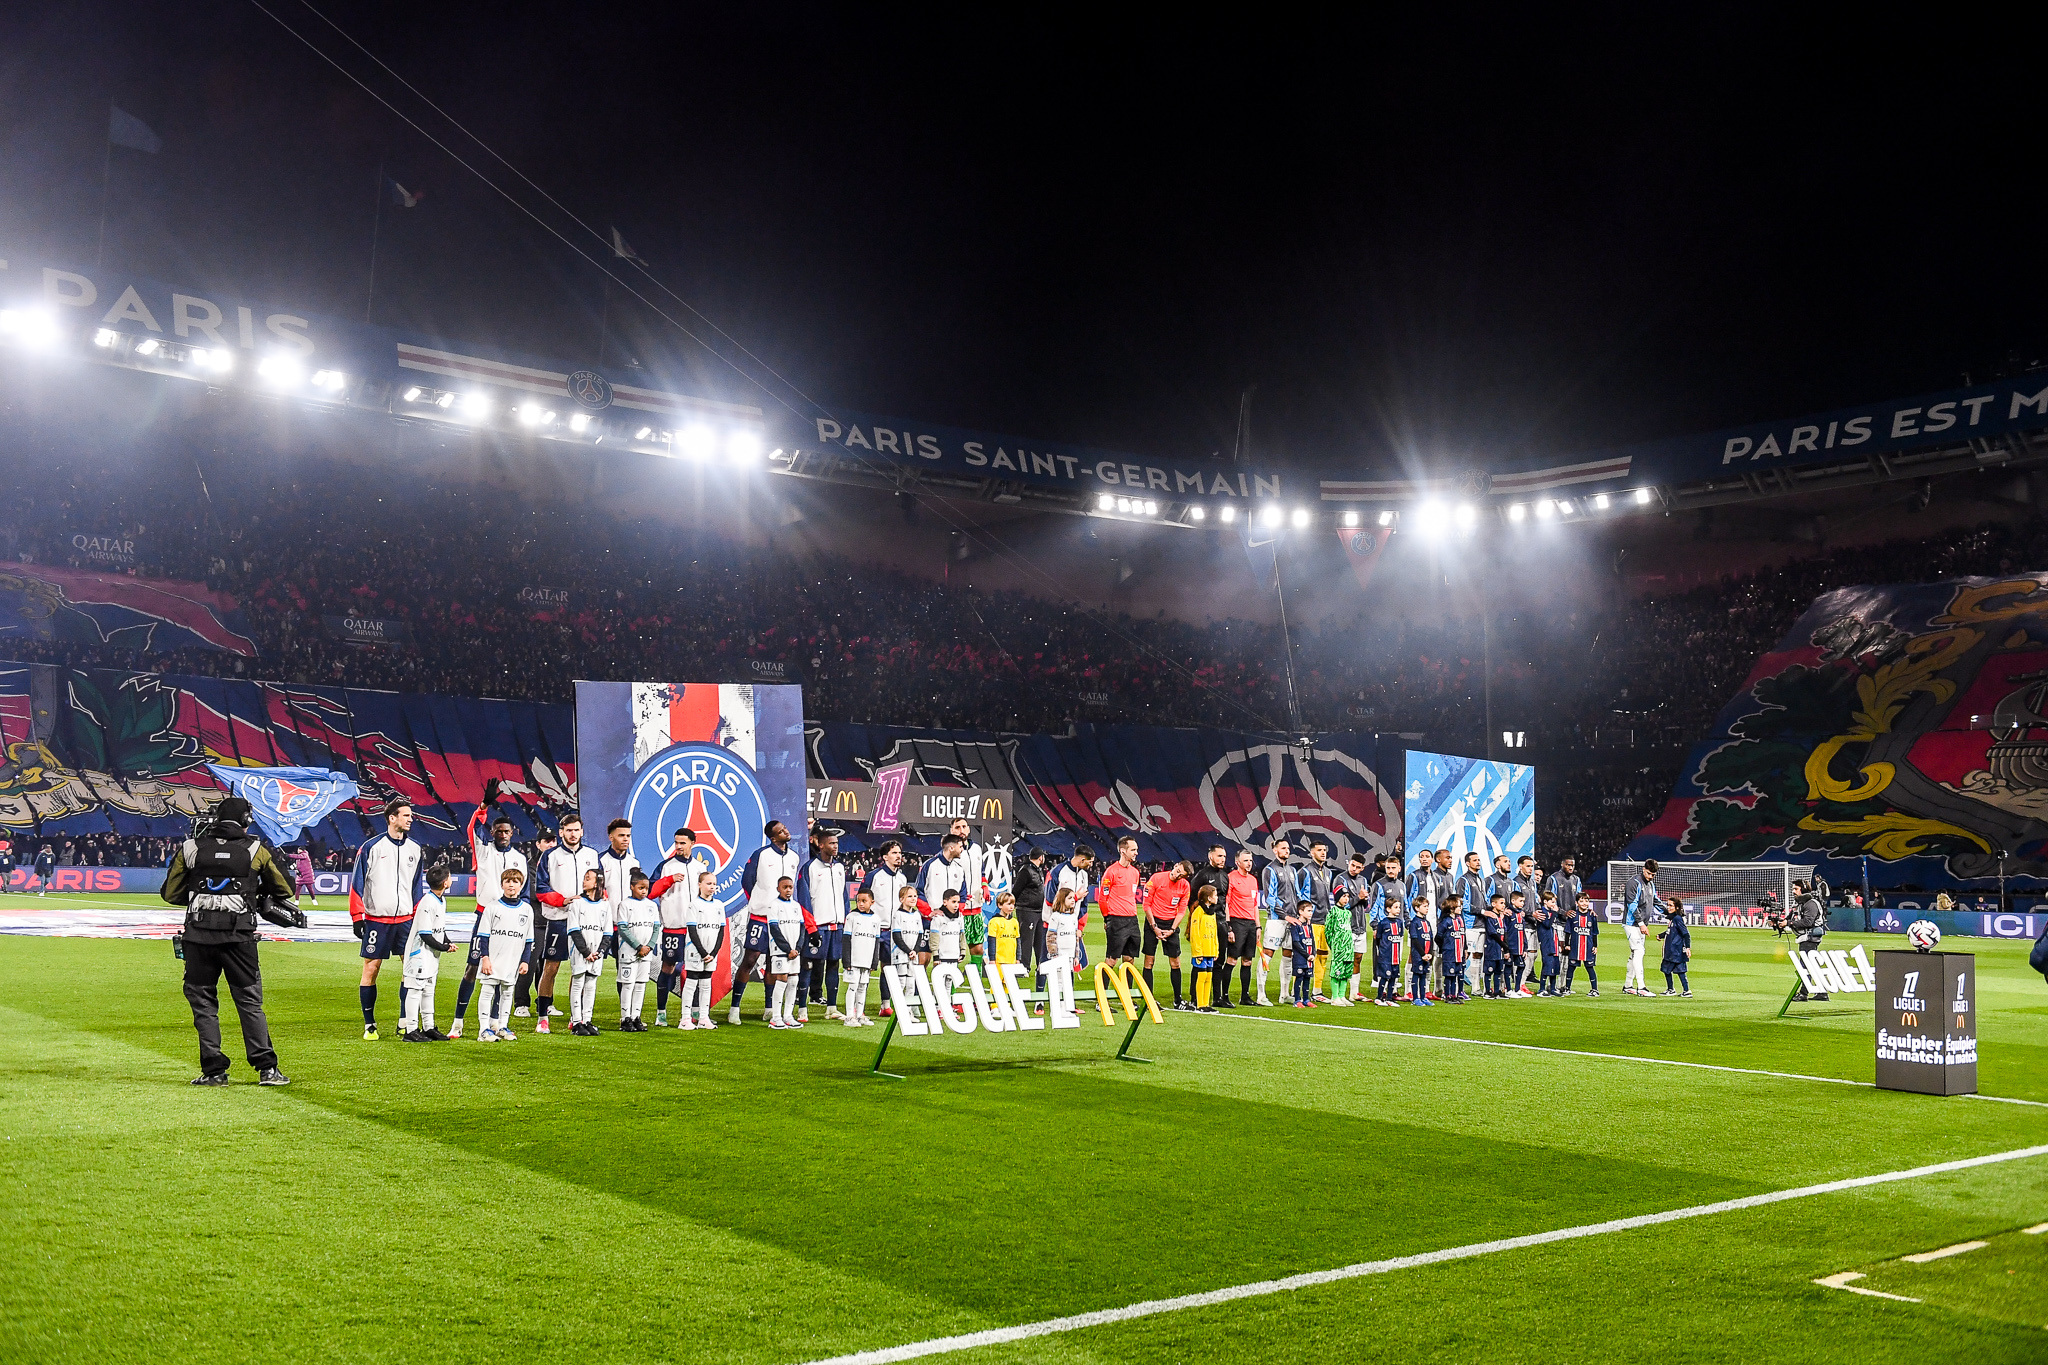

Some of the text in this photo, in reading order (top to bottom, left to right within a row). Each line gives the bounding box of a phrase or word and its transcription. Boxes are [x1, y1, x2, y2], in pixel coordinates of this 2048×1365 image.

[42, 267, 316, 357] PARIS
[1722, 416, 1873, 465] PARIS
[1891, 395, 1995, 439] EST
[816, 418, 1281, 499] PARIS SAINT-GERMAIN
[72, 534, 134, 554] QATAR
[88, 550, 134, 563] AIRWAYS
[522, 586, 569, 602] QATAR
[344, 618, 384, 630] QATAR
[752, 660, 784, 672] QATAR
[650, 760, 741, 798] PARIS
[923, 795, 966, 818] LIGUE
[714, 865, 745, 897] RMAIN
[507, 930, 524, 939] CGM
[750, 925, 763, 939] 51
[1984, 914, 2034, 936] ICI
[368, 930, 378, 944] 8
[551, 934, 559, 947] 7
[665, 936, 679, 950] 33
[1788, 950, 1866, 994] LIGUE
[883, 964, 1045, 1036] LIGUE
[1893, 997, 1926, 1012] LIGUE 1
[1952, 1000, 1965, 1013] LIGUE
[1878, 1028, 1944, 1051] Équipier
[1945, 1033, 1977, 1054] Équipier
[1877, 1046, 1944, 1065] du match
[1945, 1050, 1978, 1065] du match
